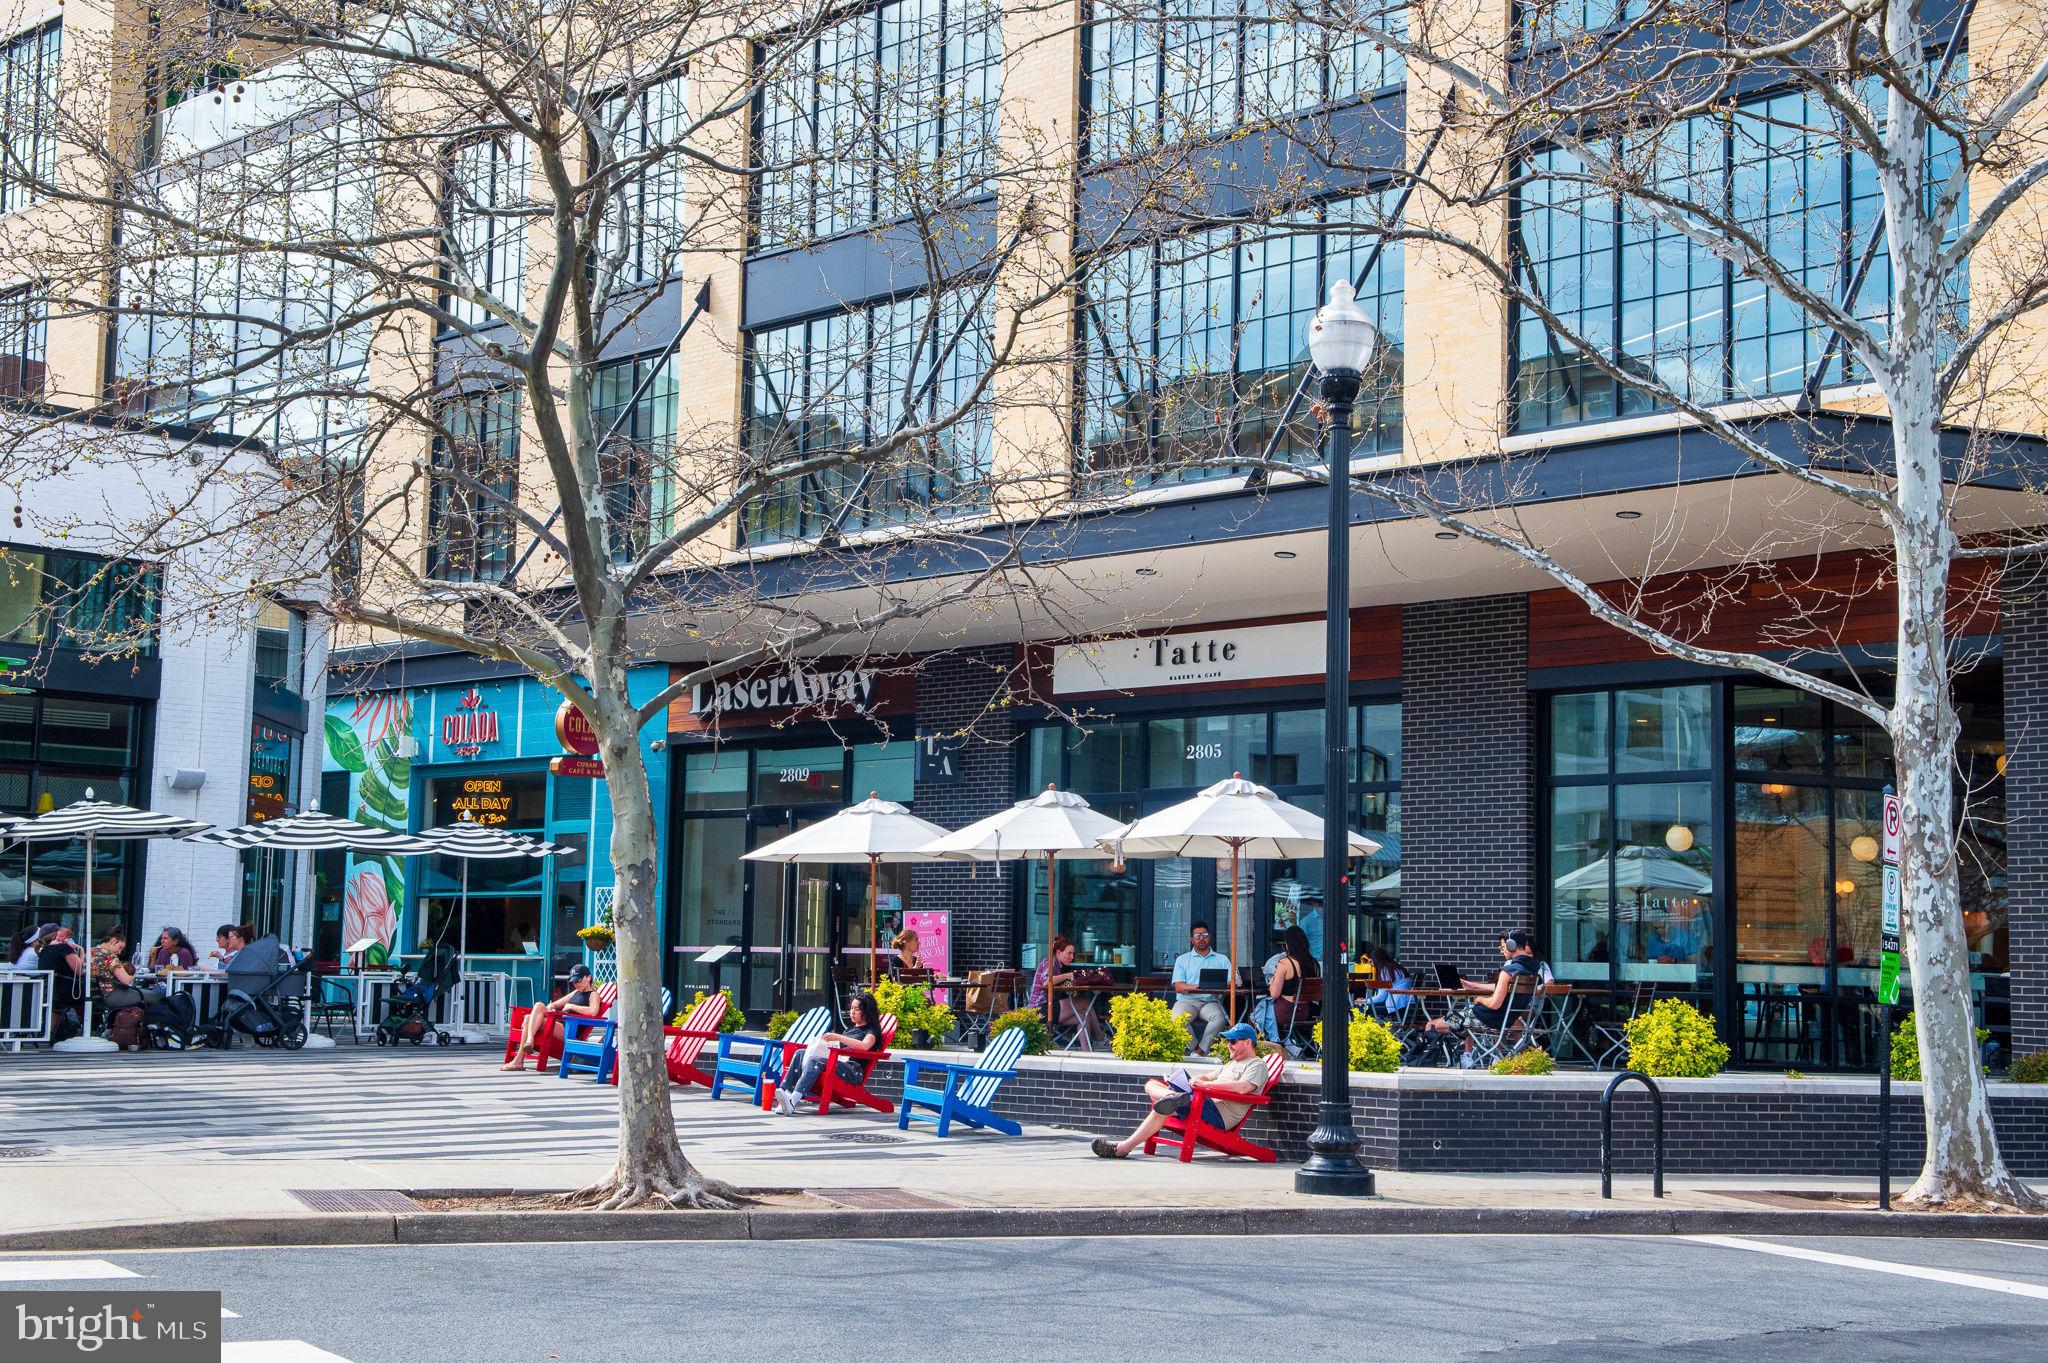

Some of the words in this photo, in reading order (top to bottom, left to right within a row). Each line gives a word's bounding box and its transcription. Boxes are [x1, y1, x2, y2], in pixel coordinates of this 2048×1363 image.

[1149, 639, 1237, 667] Tatte
[689, 664, 879, 714] LaserAway
[442, 711, 499, 745] COLADA
[568, 716, 595, 734] COLA
[1186, 744, 1222, 760] 2805
[780, 768, 810, 782] 2809
[464, 780, 501, 792] OPEN
[453, 797, 480, 810] ALL
[481, 797, 511, 810] DAY
[1640, 893, 1688, 909] Tatte
